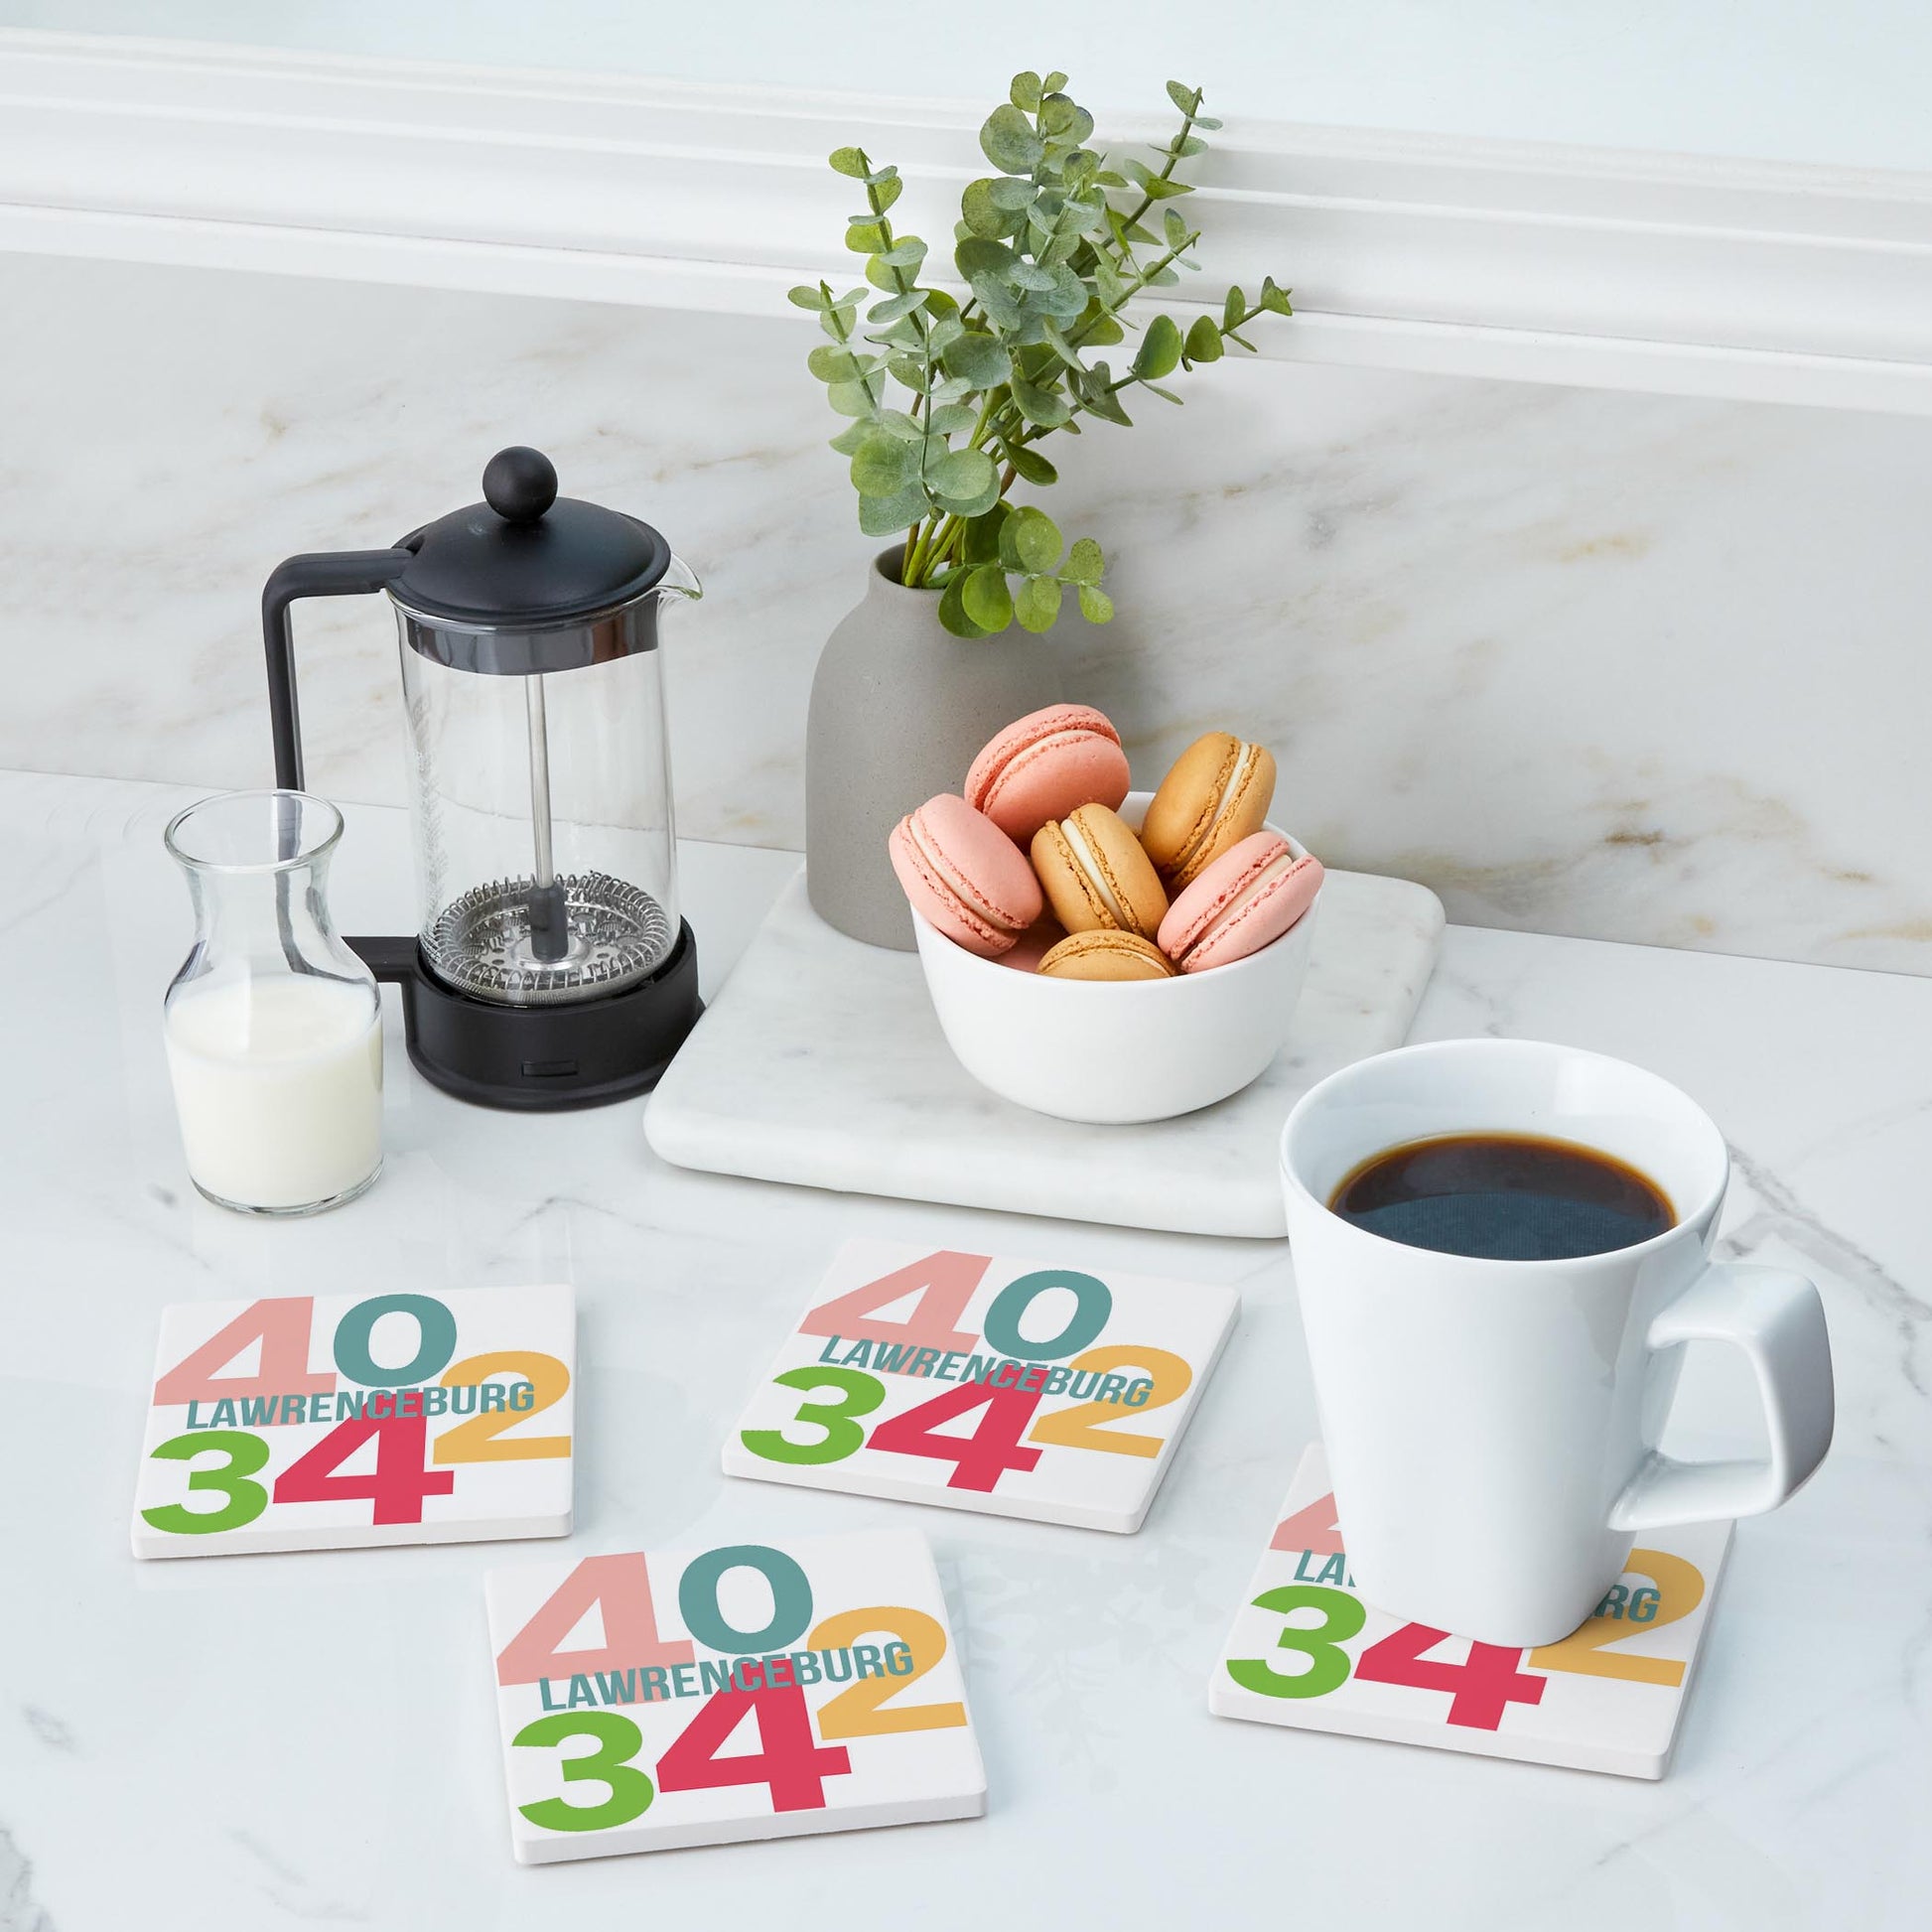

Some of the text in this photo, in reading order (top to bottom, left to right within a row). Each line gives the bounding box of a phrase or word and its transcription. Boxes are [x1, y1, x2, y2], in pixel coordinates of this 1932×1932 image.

[187, 1382, 535, 1429] LAWRENCEBURG
[818, 1334, 1155, 1407] LAWRENCEBURG
[539, 1641, 915, 1712] LAWRENCEBURG
